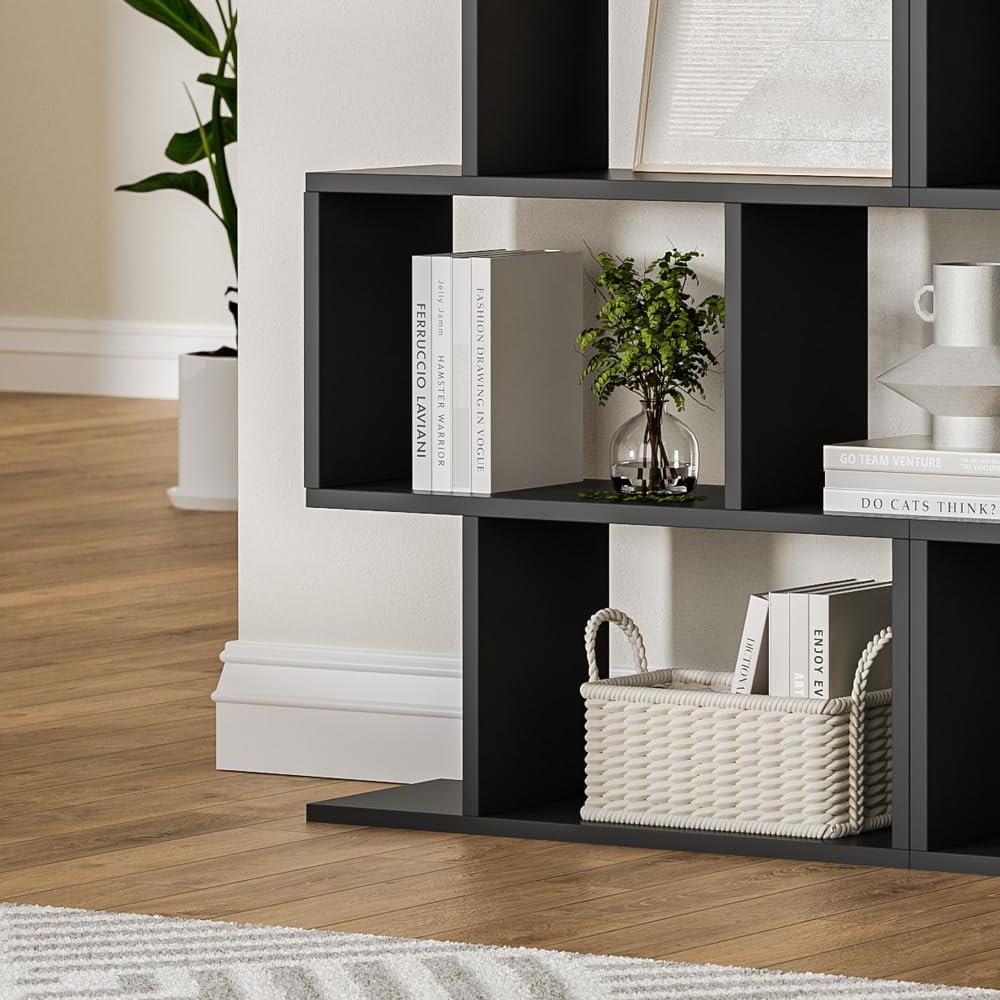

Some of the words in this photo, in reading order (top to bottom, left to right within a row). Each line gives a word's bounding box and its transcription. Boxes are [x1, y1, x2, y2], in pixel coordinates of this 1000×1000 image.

[436, 279, 445, 304] Jelly
[475, 287, 485, 343] FASHION
[436, 307, 445, 336] Jamm
[416, 303, 427, 390] FERRUCCIO
[436, 355, 446, 409] HAMSTER
[475, 346, 485, 407] DRAWING
[416, 395, 427, 459] LAVIANI
[436, 414, 446, 467] WARRIOR
[475, 410, 485, 424] IN
[475, 428, 485, 473] VOGUE
[839, 453, 856, 465] GO
[857, 454, 889, 466] TEAM
[891, 455, 943, 469] VENTURE
[861, 497, 883, 510] DO
[890, 499, 930, 512] CATS
[937, 501, 997, 516] THINK?
[735, 638, 755, 695] DICTIONA
[813, 629, 824, 675] ENJOY
